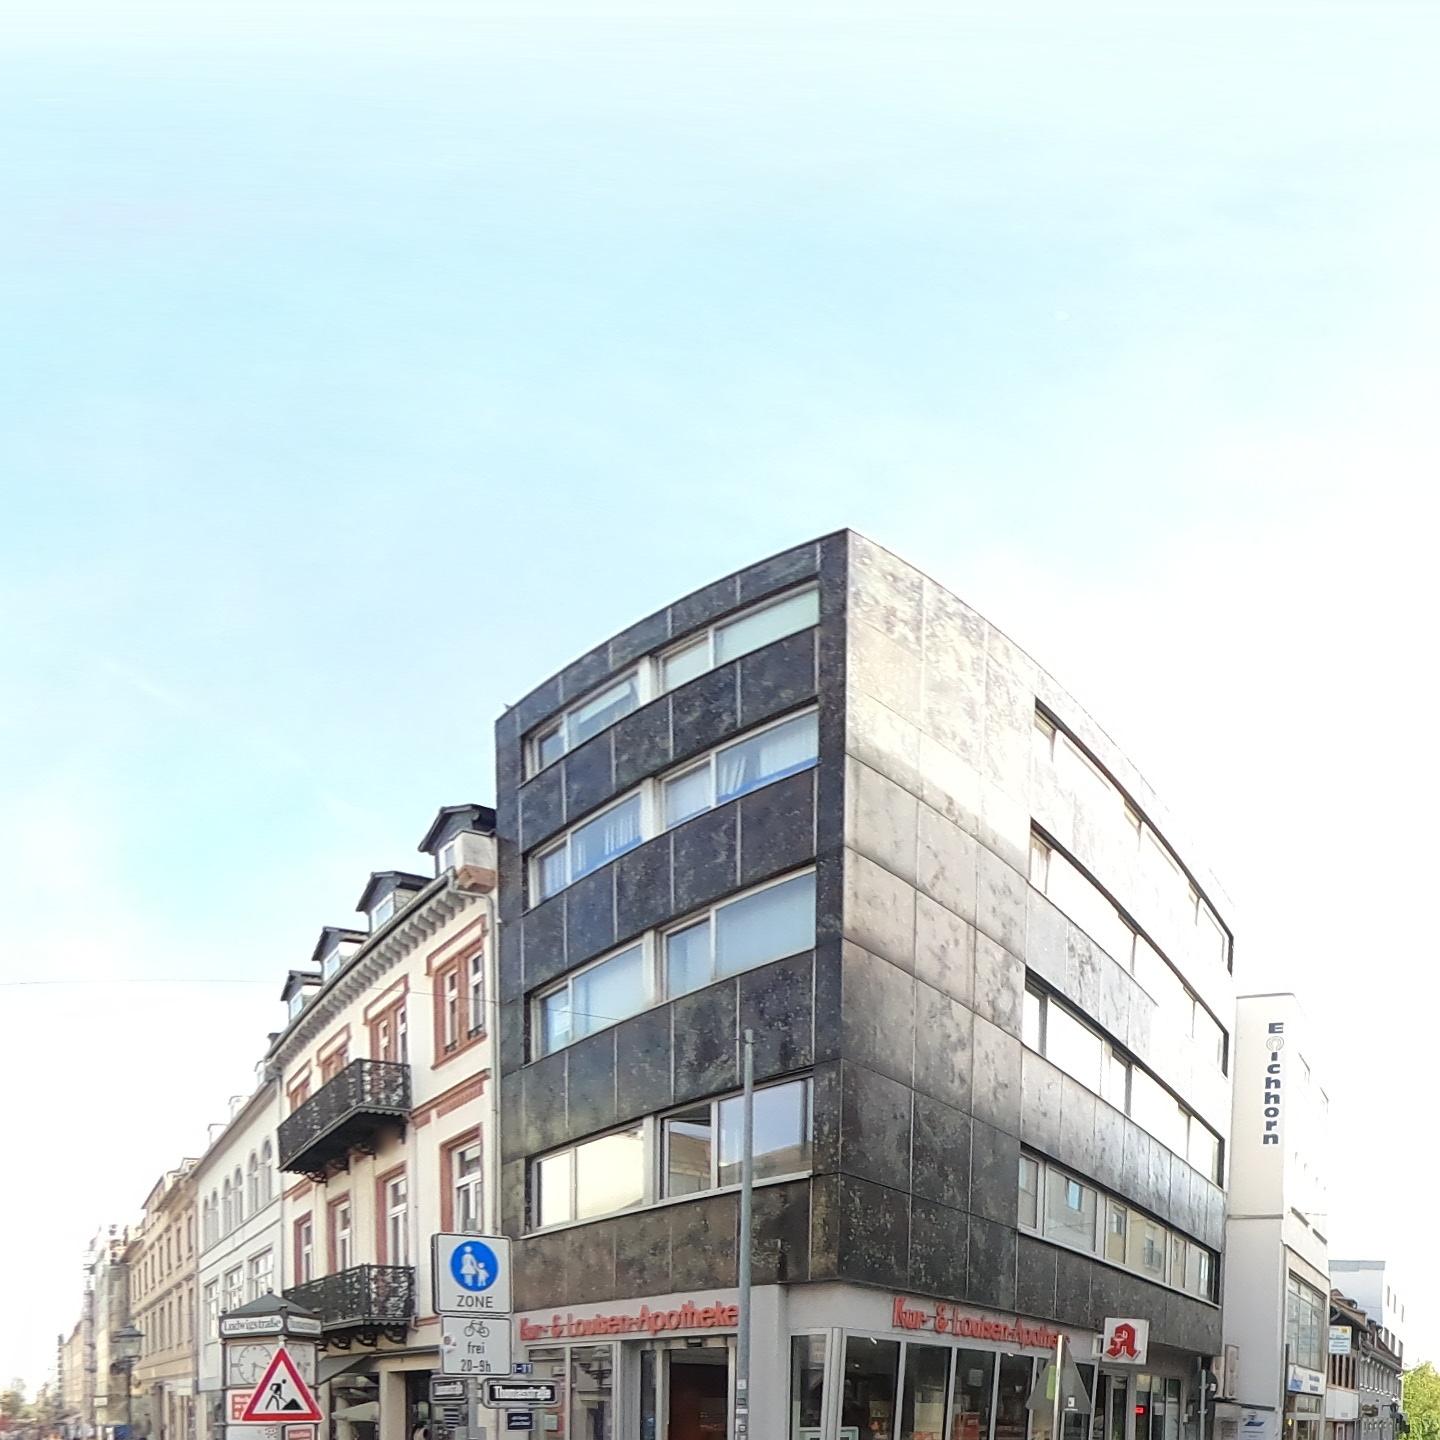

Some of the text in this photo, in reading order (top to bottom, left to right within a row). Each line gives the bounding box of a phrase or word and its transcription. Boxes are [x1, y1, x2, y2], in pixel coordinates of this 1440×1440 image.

[1263, 1022, 1284, 1145] Eichhorn
[457, 1295, 493, 1308] ZONE
[892, 1295, 927, 1330] Kur-
[934, 1301, 949, 1334] &
[519, 1317, 548, 1341] Kur-
[566, 1300, 739, 1337] Louisen-Apotheke
[467, 1341, 485, 1354] frei
[461, 1359, 492, 1372] 20-9h
